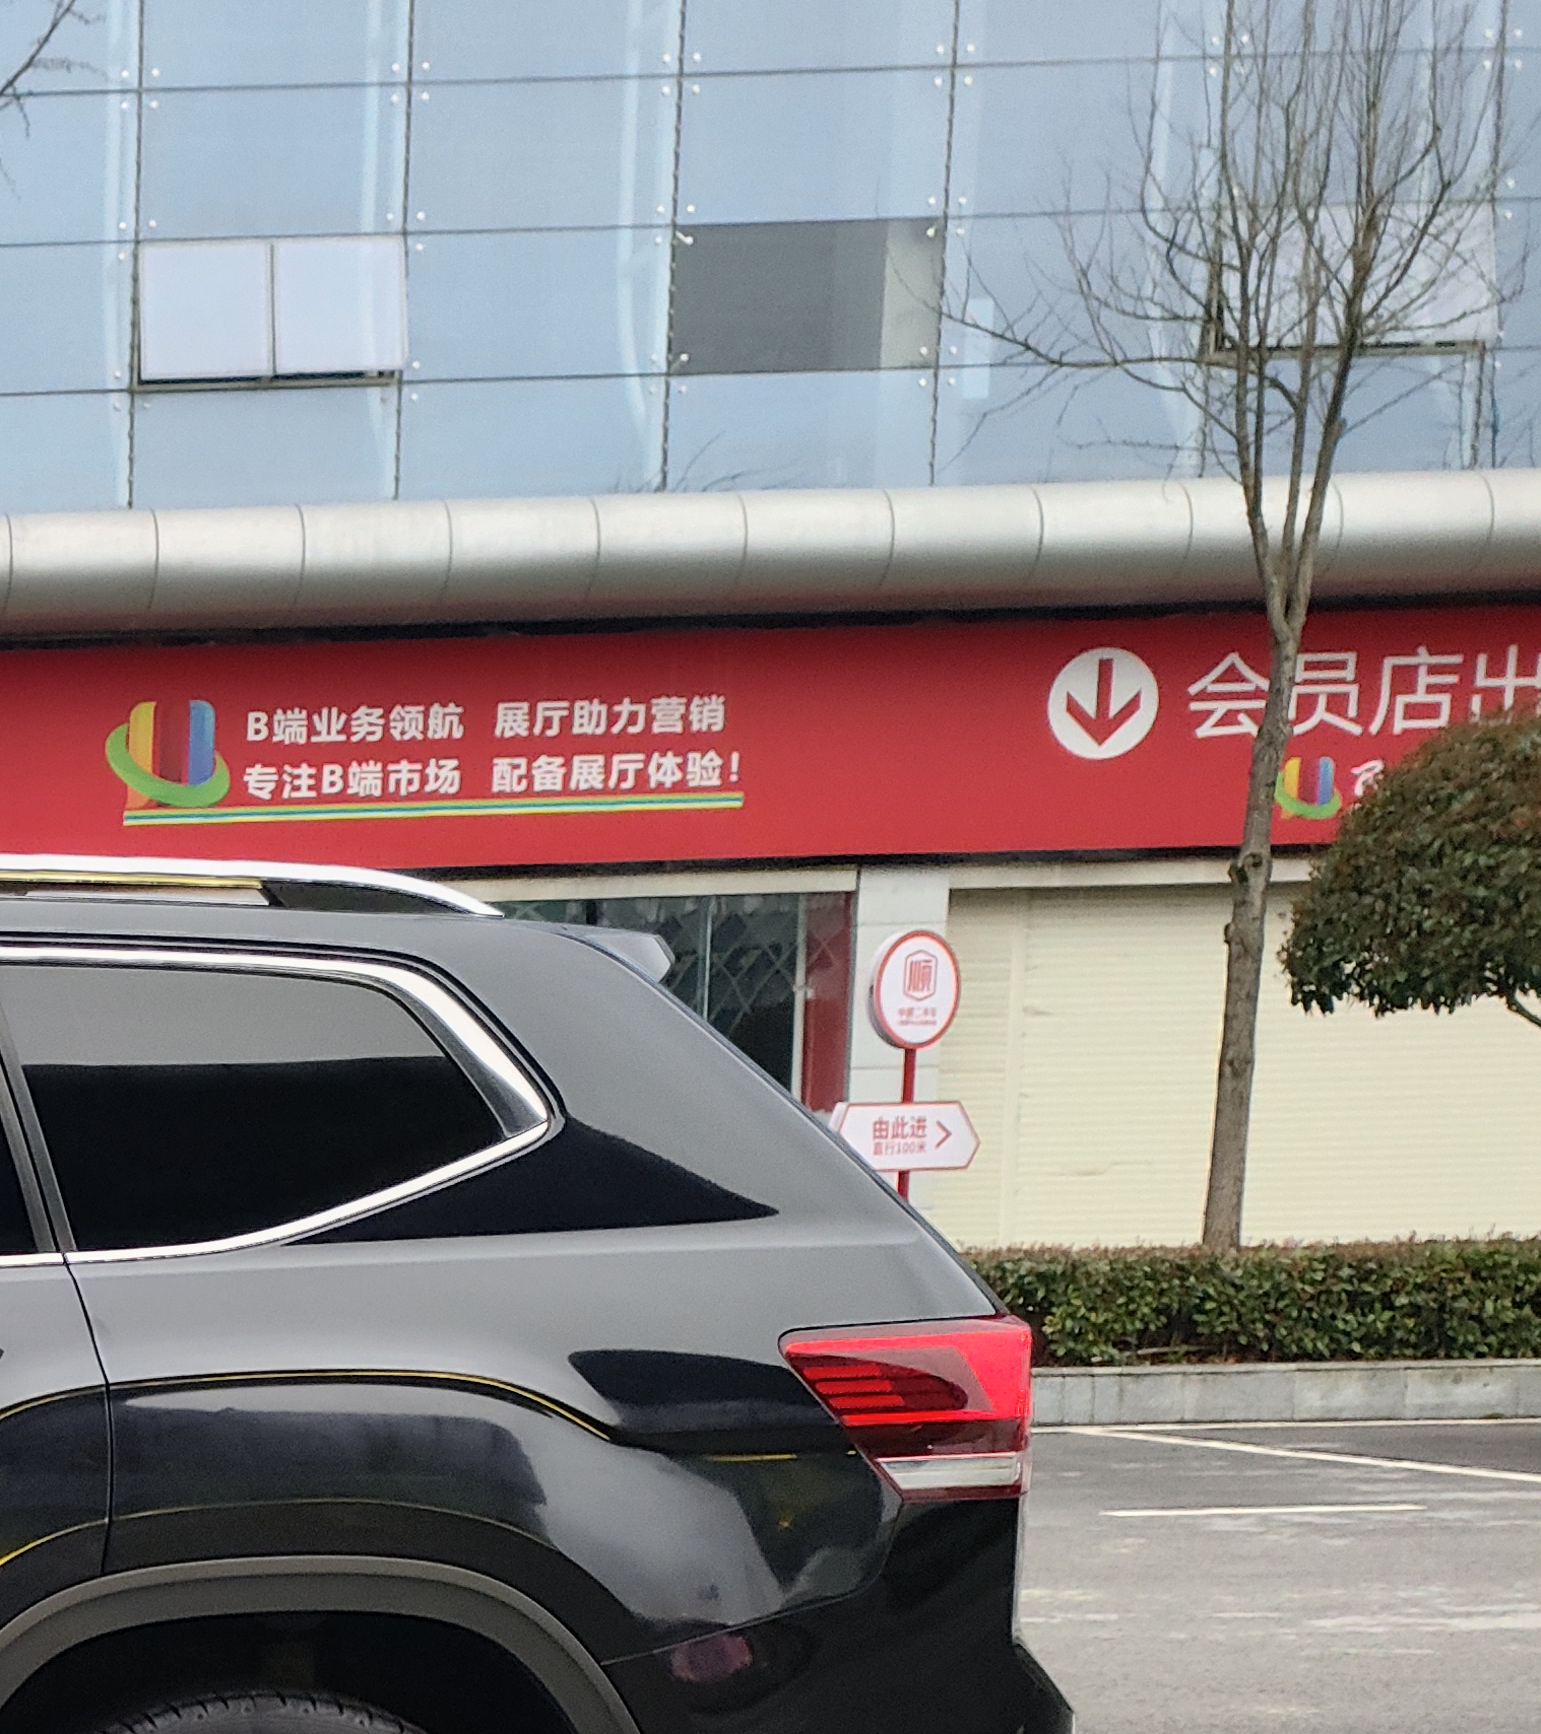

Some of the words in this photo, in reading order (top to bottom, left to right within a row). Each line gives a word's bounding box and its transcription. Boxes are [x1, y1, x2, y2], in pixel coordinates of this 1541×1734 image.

[245, 702, 465, 745] B端业务领航
[494, 694, 726, 738] 展厅助力营销
[243, 757, 462, 800] 专注B端市场
[491, 750, 741, 793] 配备展厅体验!
[872, 1115, 927, 1140] 由此进
